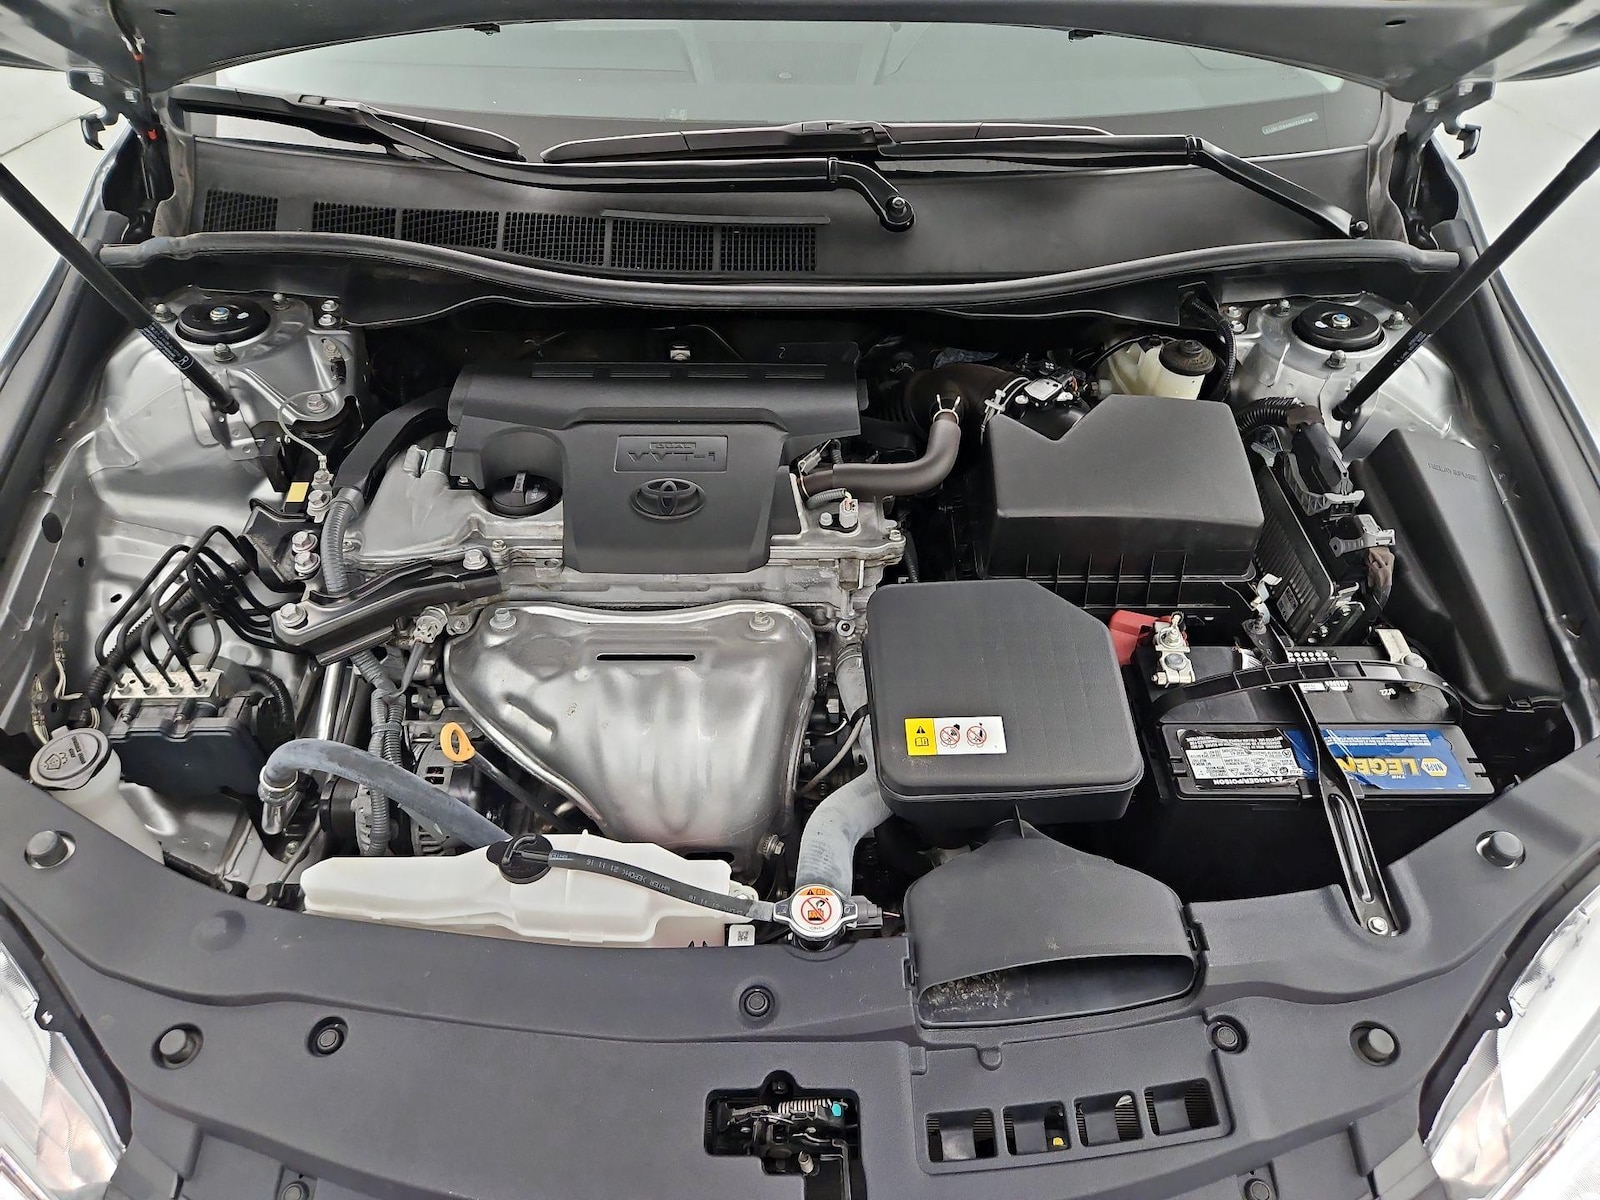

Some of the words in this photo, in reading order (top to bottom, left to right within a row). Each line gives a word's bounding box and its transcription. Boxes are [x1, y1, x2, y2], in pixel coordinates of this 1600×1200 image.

[1334, 755, 1419, 776] LEGEN
[1423, 762, 1444, 771] NAPA
[1212, 776, 1275, 785] DANGER/POISON
[649, 878, 671, 891] WATER
